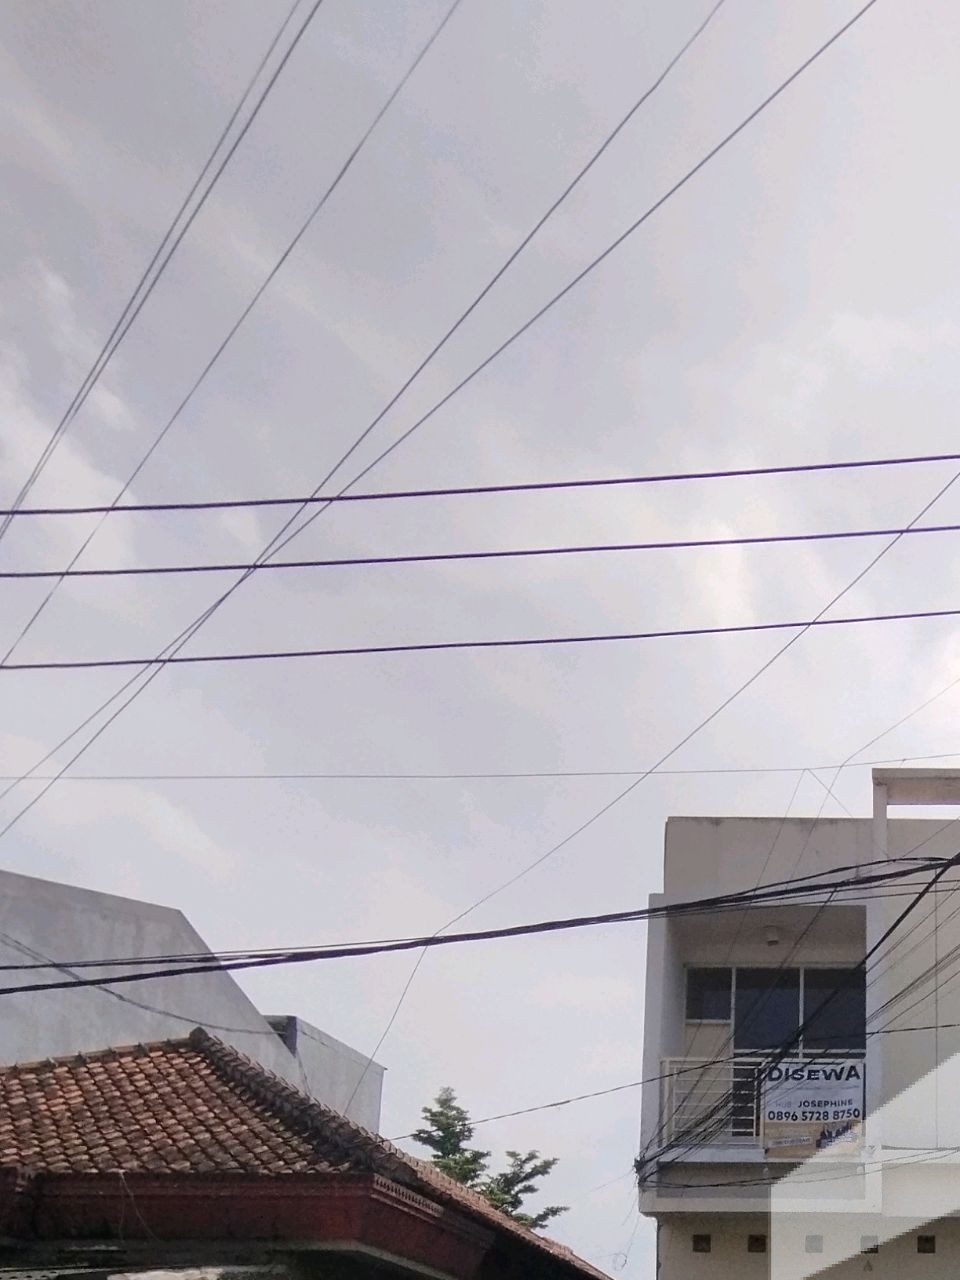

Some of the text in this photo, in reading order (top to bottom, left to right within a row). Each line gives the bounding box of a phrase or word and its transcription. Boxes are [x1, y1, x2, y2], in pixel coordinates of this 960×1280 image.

[768, 1065, 860, 1081] DISEWA
[798, 1099, 853, 1108] JOSEPHINE
[768, 1108, 860, 1121] 0896 5728 8750
